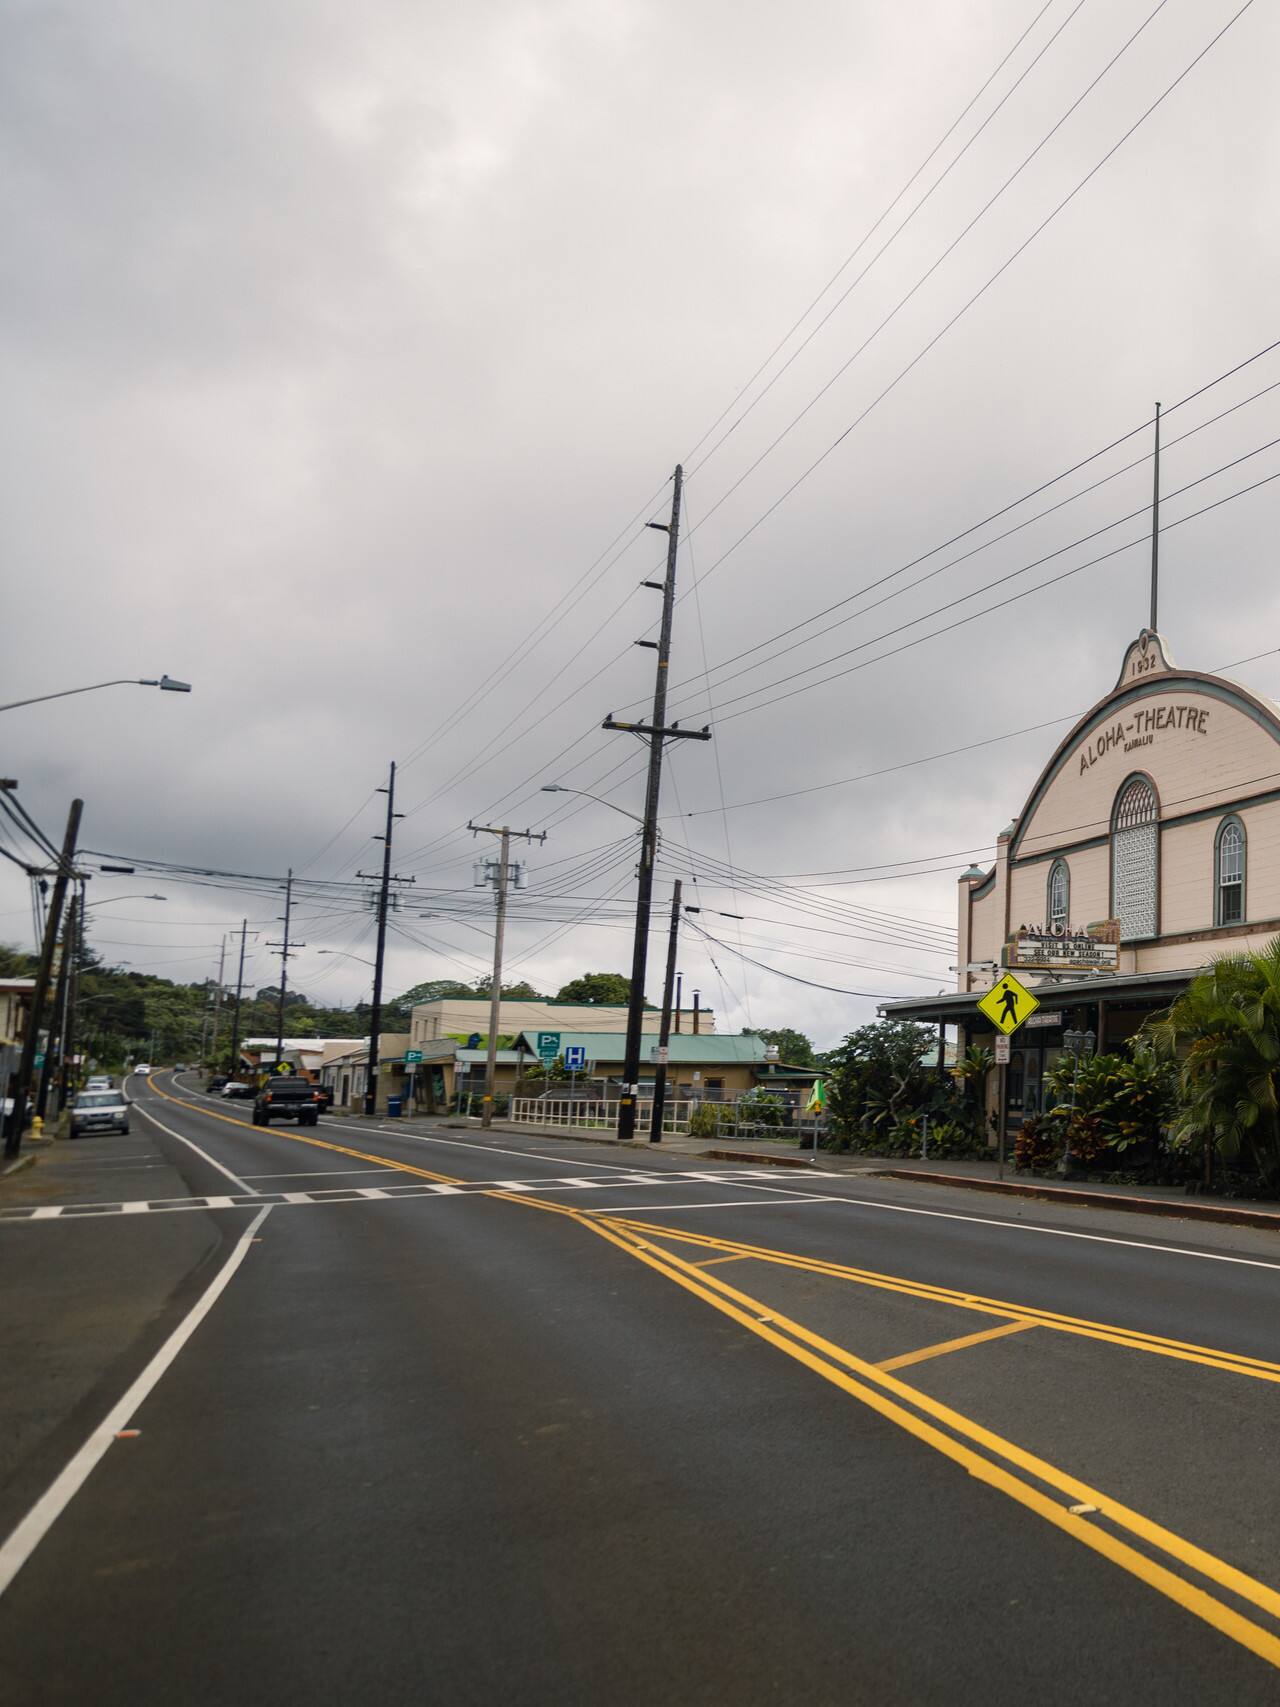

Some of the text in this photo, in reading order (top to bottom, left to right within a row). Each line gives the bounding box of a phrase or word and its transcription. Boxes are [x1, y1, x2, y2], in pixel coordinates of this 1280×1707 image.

[1132, 654, 1156, 676] 1932
[1026, 922, 1089, 938] ALOHA
[1073, 943, 1095, 951] ONLINE
[1034, 949, 1045, 957] SEE
[541, 1035, 551, 1047] P
[34, 1055, 45, 1065] P
[407, 1052, 417, 1060] P
[568, 1048, 582, 1064] H
